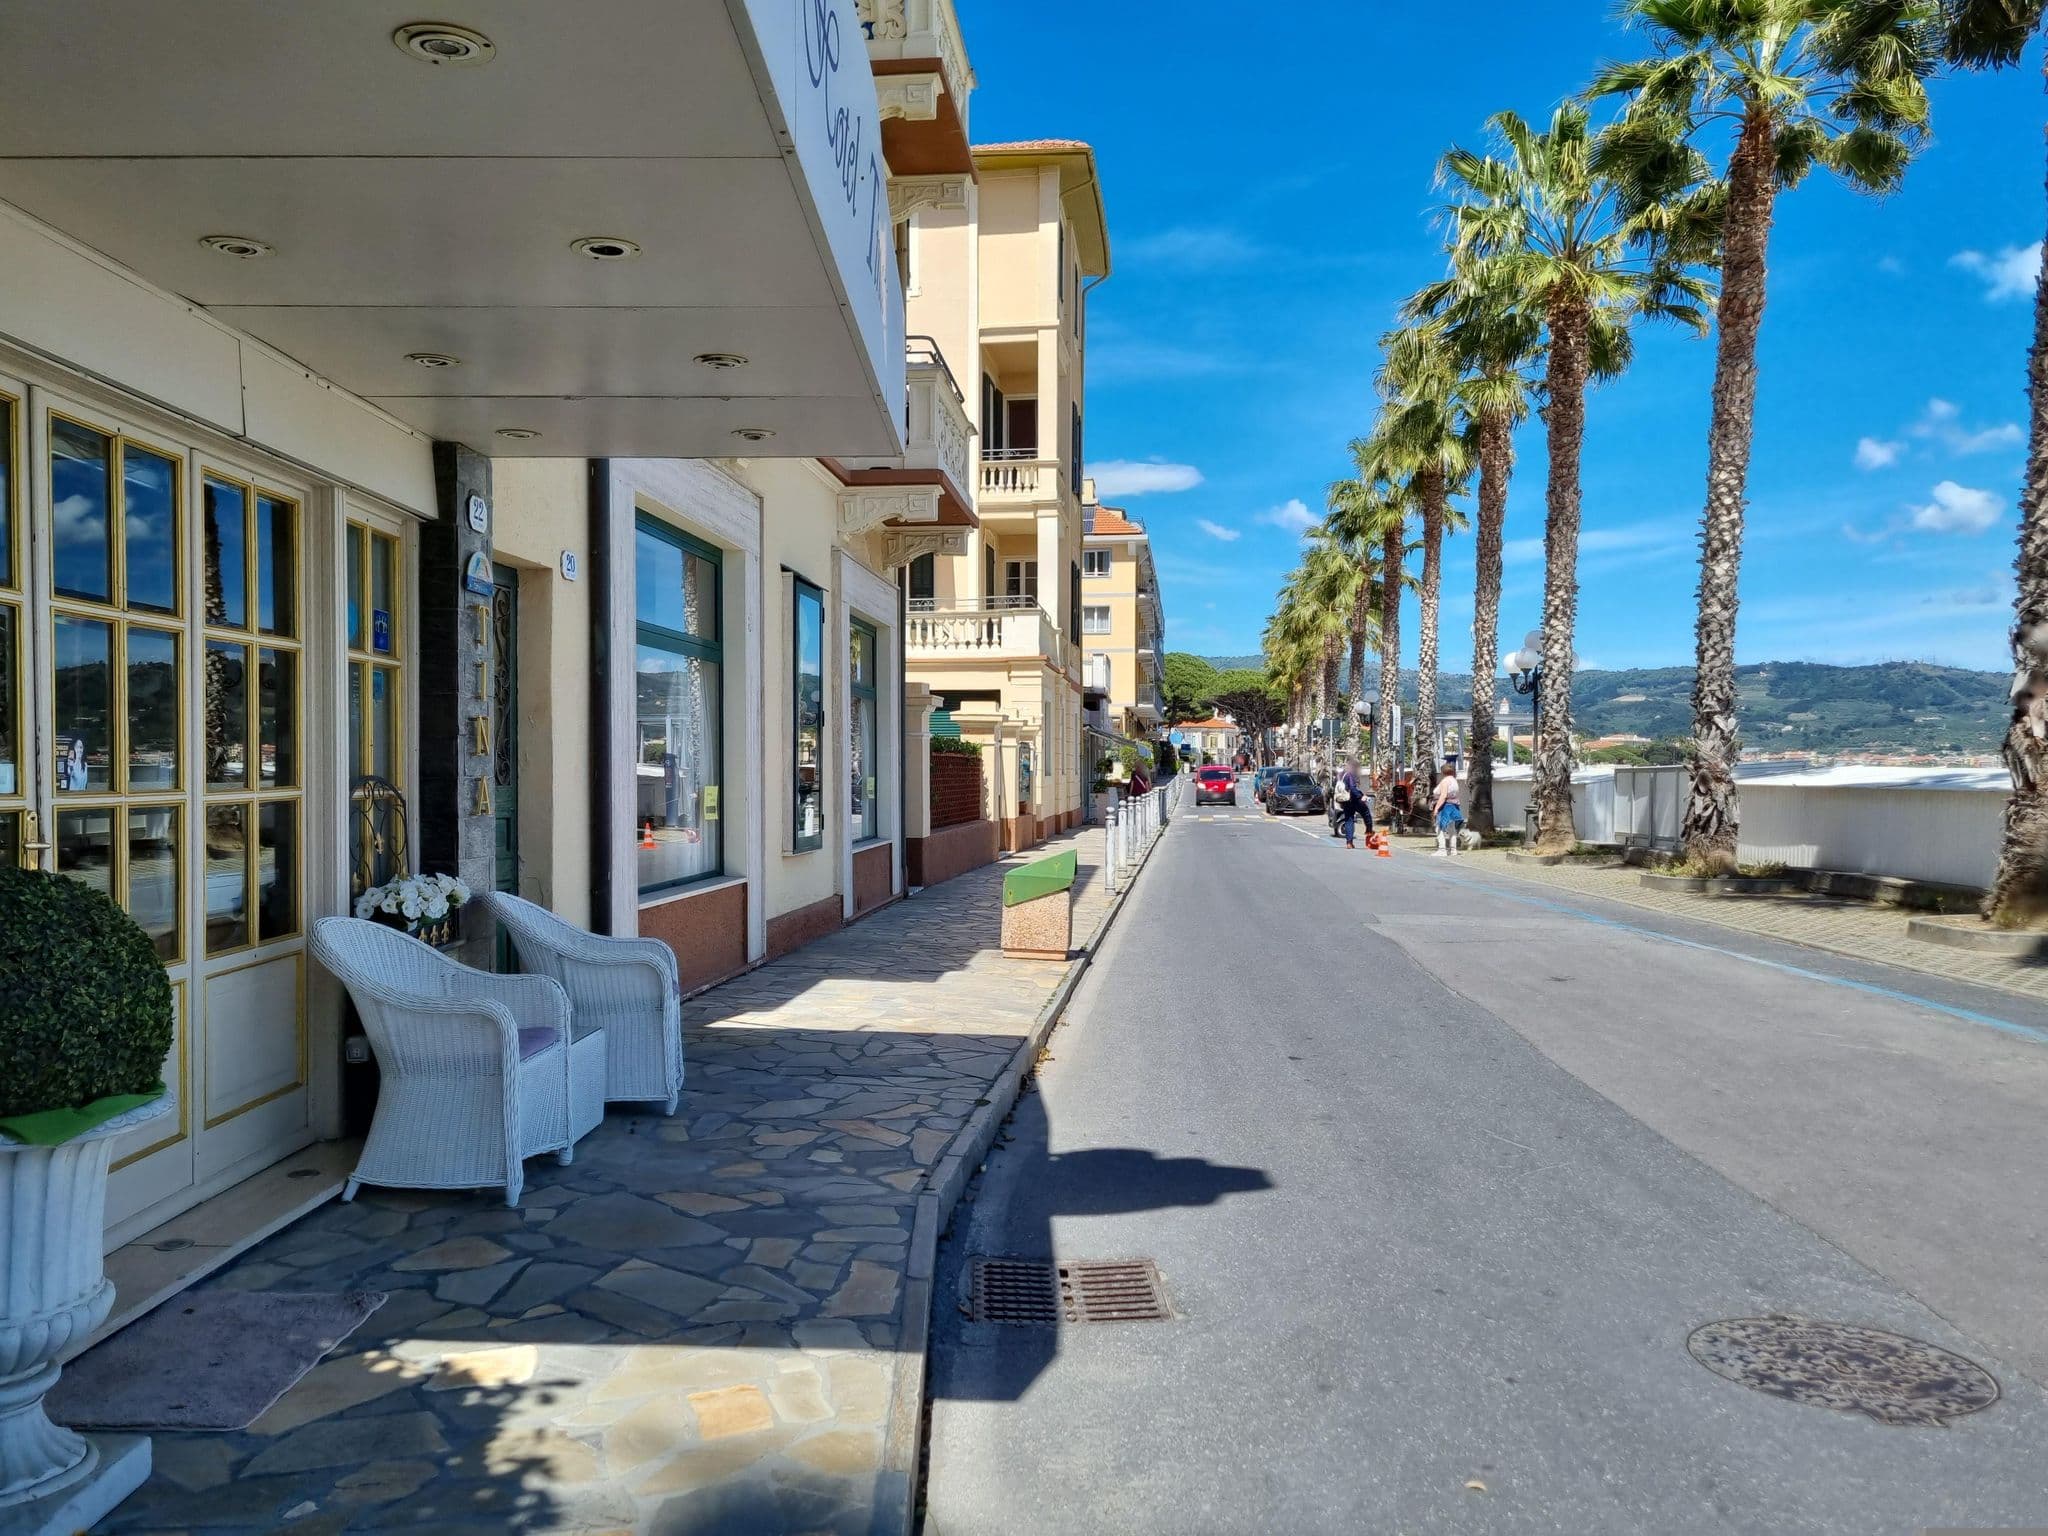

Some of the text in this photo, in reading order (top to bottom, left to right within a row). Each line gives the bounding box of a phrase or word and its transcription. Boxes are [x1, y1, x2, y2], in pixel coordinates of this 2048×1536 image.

[473, 498, 484, 522] 22
[566, 553, 576, 573] 20
[474, 605, 490, 815] TINA
